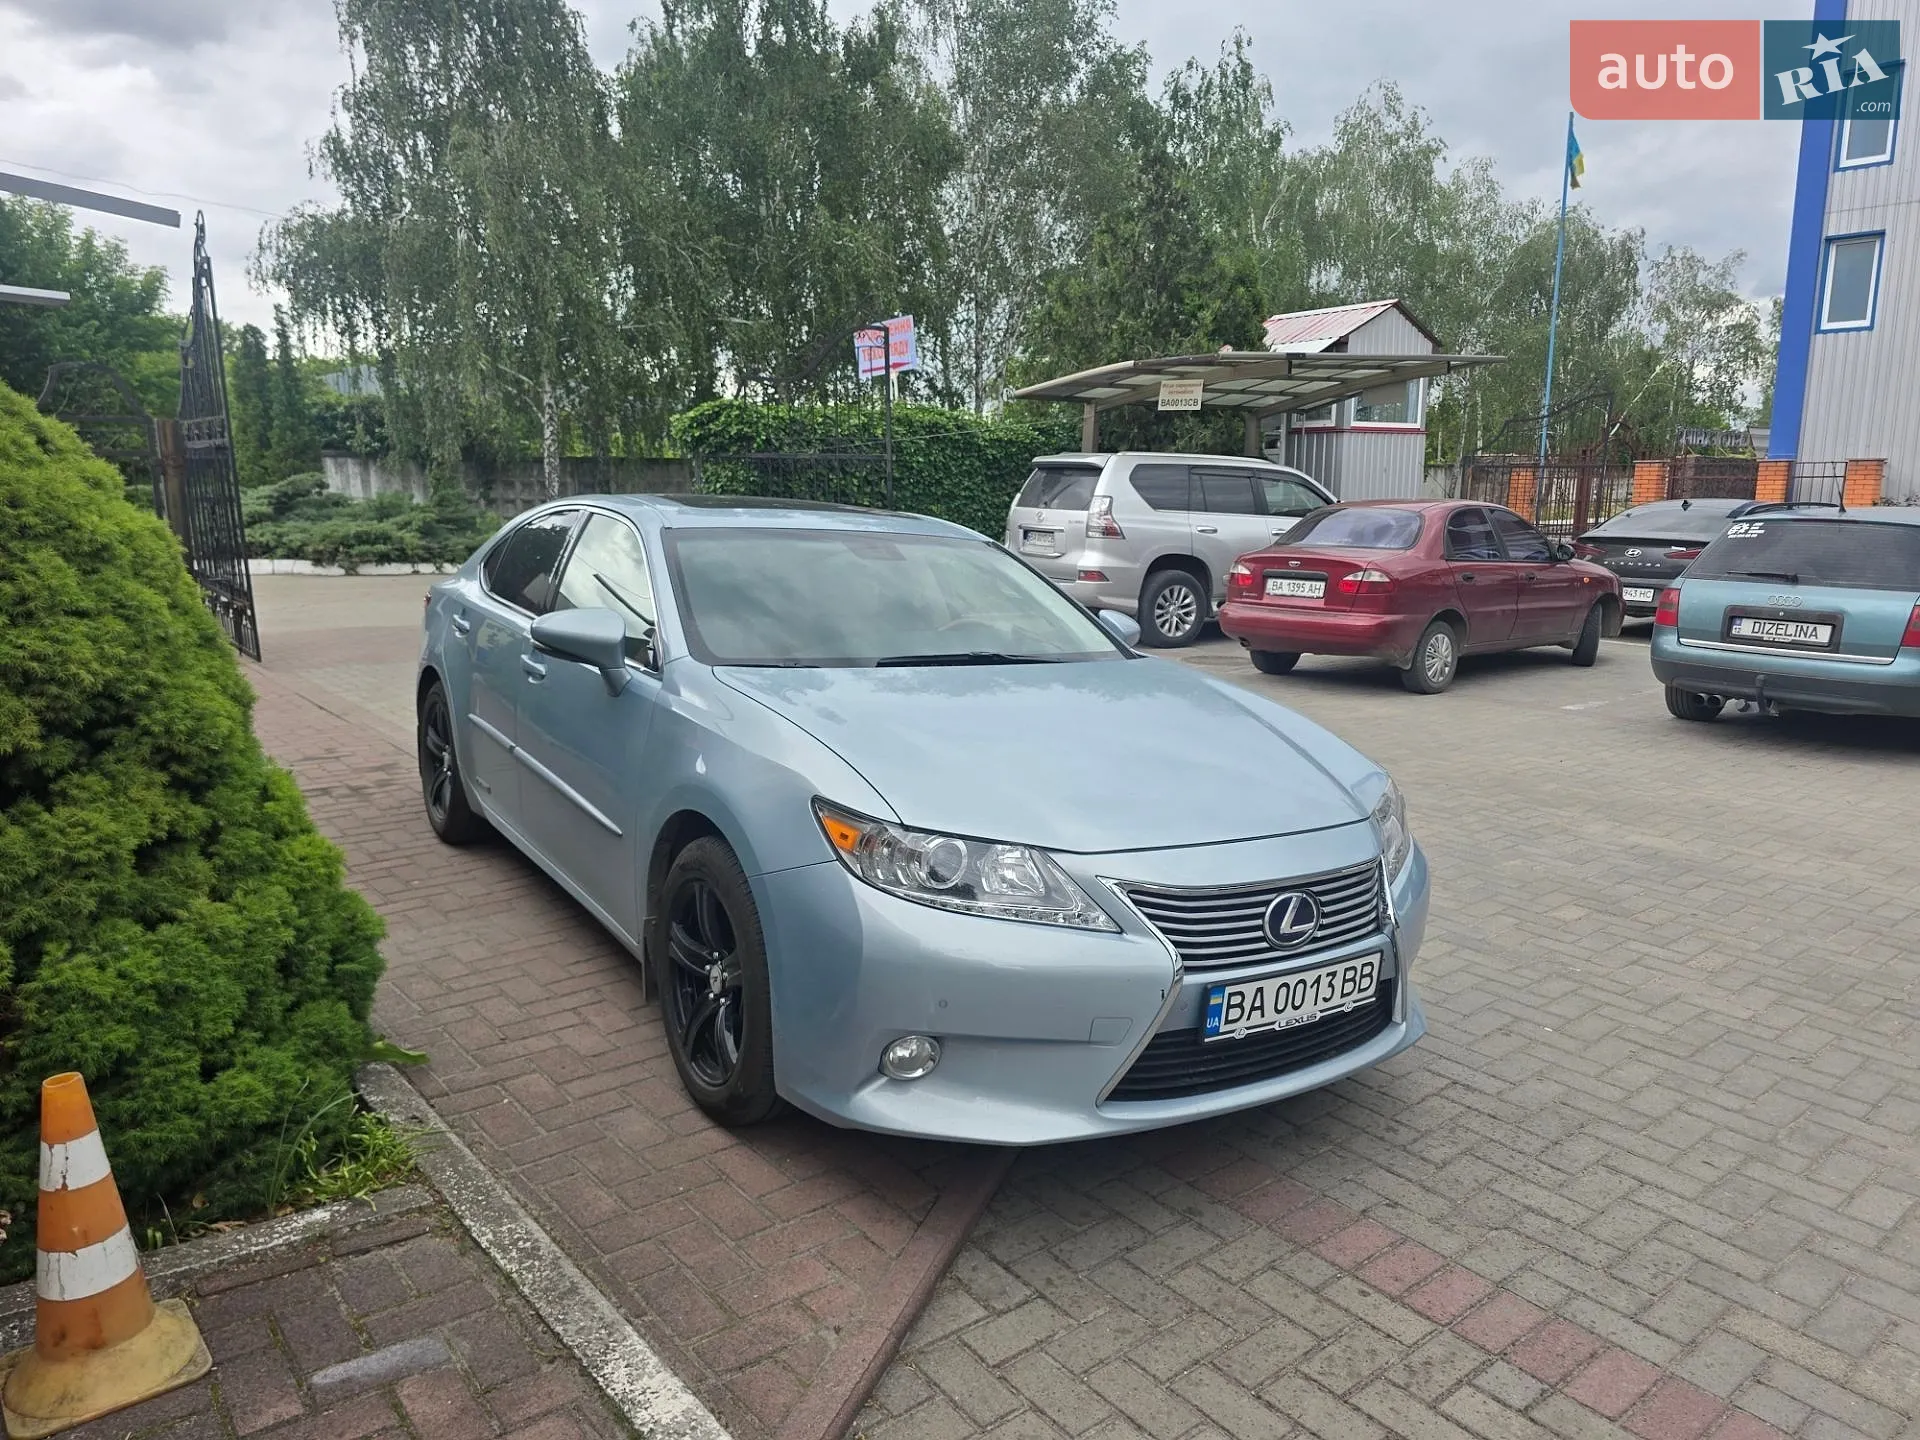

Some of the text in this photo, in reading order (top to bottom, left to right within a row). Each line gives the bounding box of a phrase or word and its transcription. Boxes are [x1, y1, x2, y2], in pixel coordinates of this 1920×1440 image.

[1271, 581, 1322, 594] BA 1395 AH
[1623, 589, 1638, 598] 943
[1751, 621, 1819, 640] DIZELINA
[1223, 961, 1375, 1026] BA 0013 BB
[1206, 1017, 1220, 1028] UA
[1277, 1012, 1318, 1028] LEXUS
